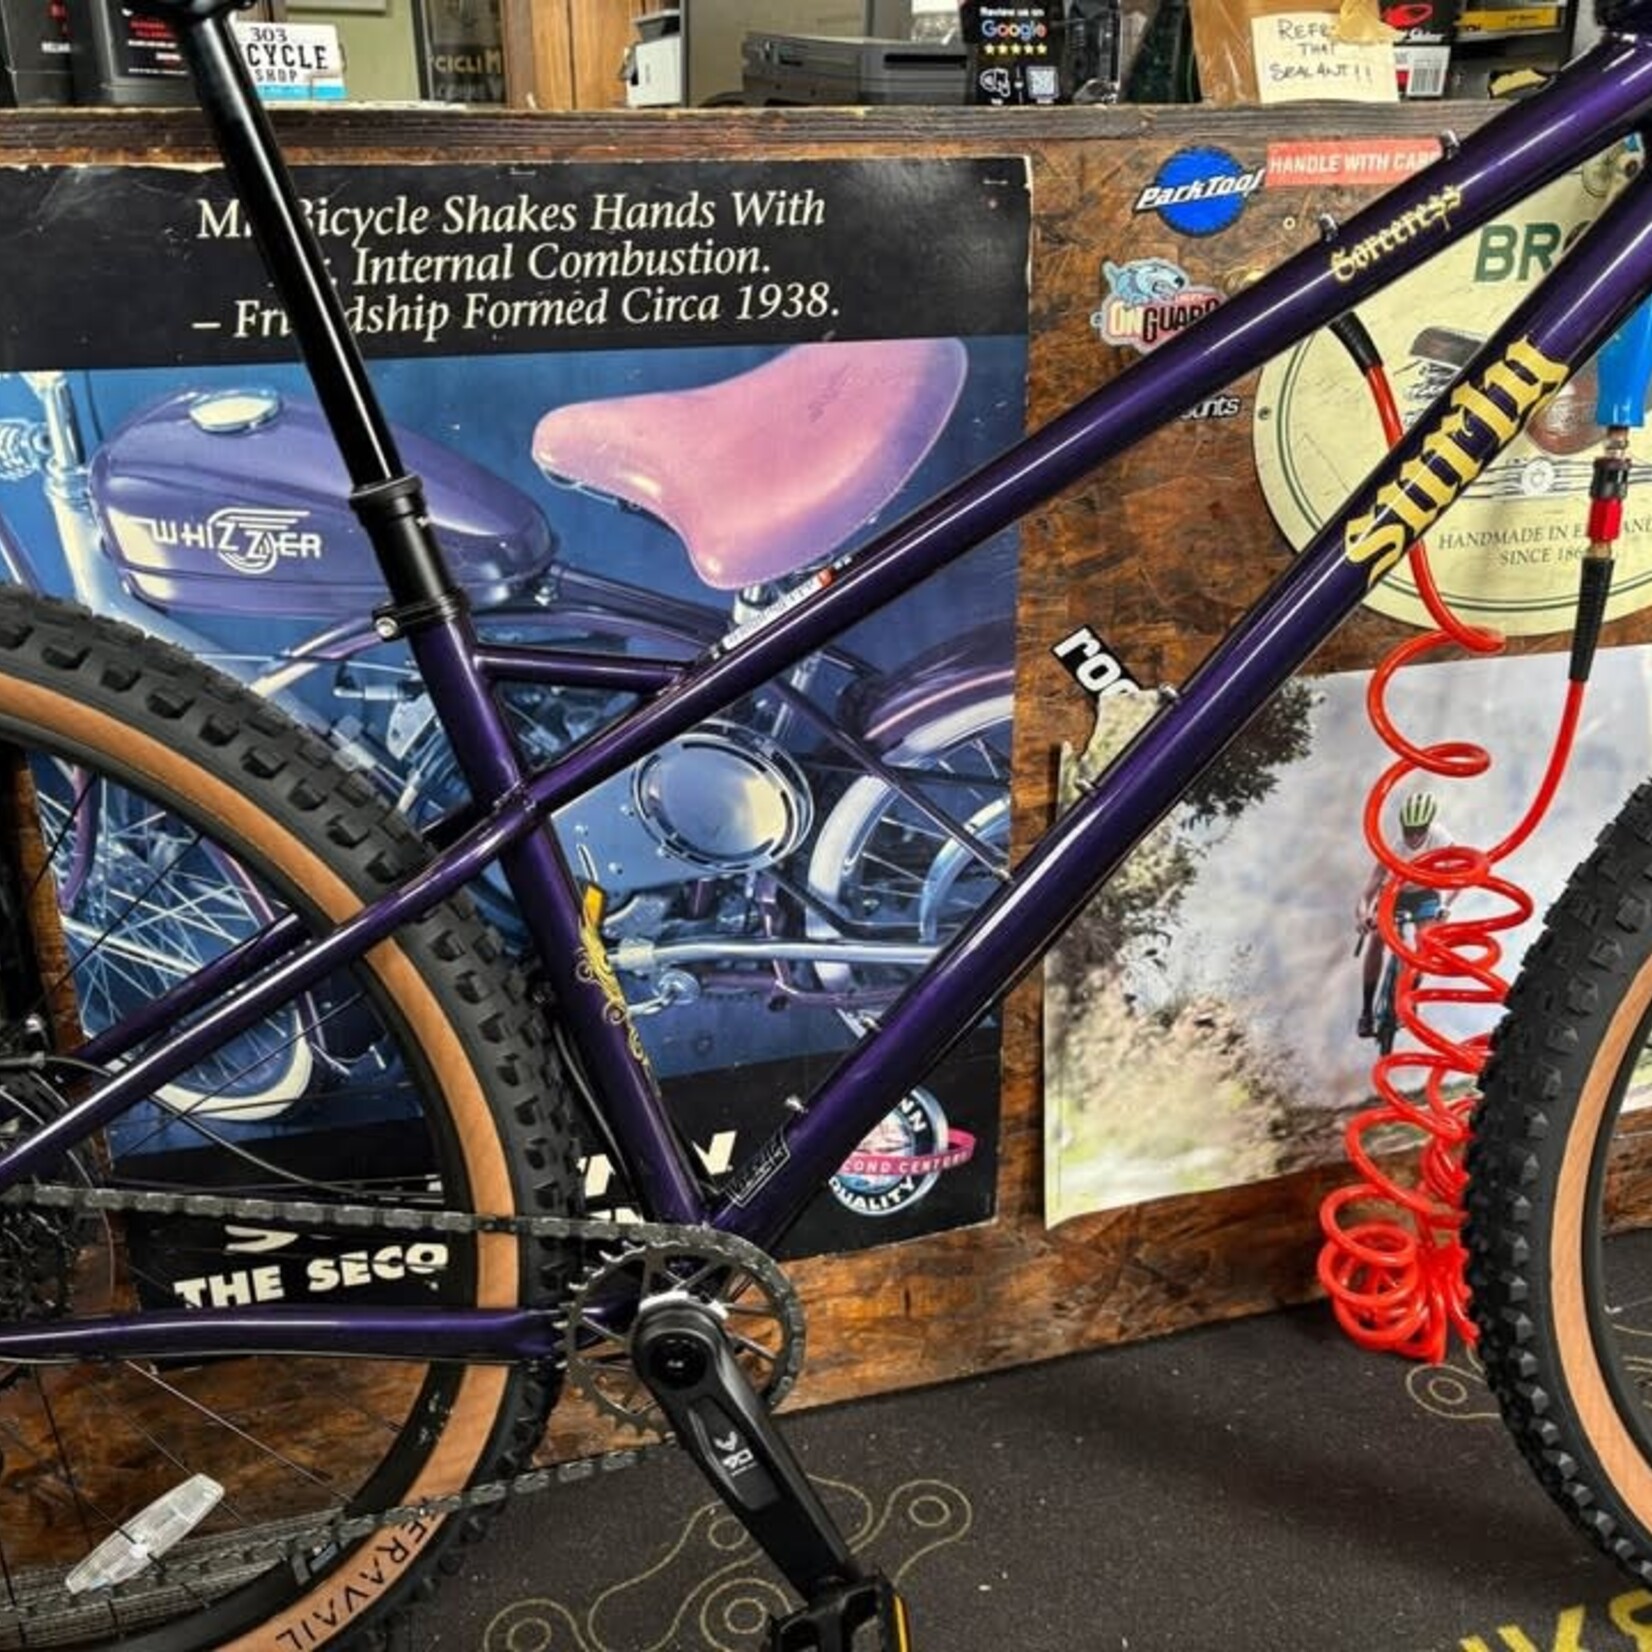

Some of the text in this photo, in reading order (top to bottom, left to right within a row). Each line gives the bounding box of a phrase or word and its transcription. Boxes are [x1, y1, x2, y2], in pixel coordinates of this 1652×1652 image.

[250, 27, 287, 42] 303
[981, 20, 1048, 41] Google
[246, 43, 329, 70] CYCLE
[255, 68, 298, 83] SHOP
[1269, 152, 1437, 174] HANDLE WITH CAR
[443, 194, 577, 234] Shakes
[591, 191, 716, 231] Hands
[732, 189, 825, 227] With
[353, 242, 513, 285] Internal
[528, 239, 770, 280] Combustion.
[463, 288, 609, 329] Formed
[621, 287, 720, 324] Circa
[736, 282, 839, 320] 1938.
[149, 508, 322, 574] WHIZZER
[1439, 526, 1543, 550] HANDMADE
[1549, 523, 1568, 542] IN
[1500, 546, 1583, 566] SINCE 186
[842, 1157, 892, 1174] COND
[828, 1175, 915, 1212] QUALITY
[173, 1243, 448, 1308] THE SECO
[275, 1499, 438, 1650] ERAVAIL
